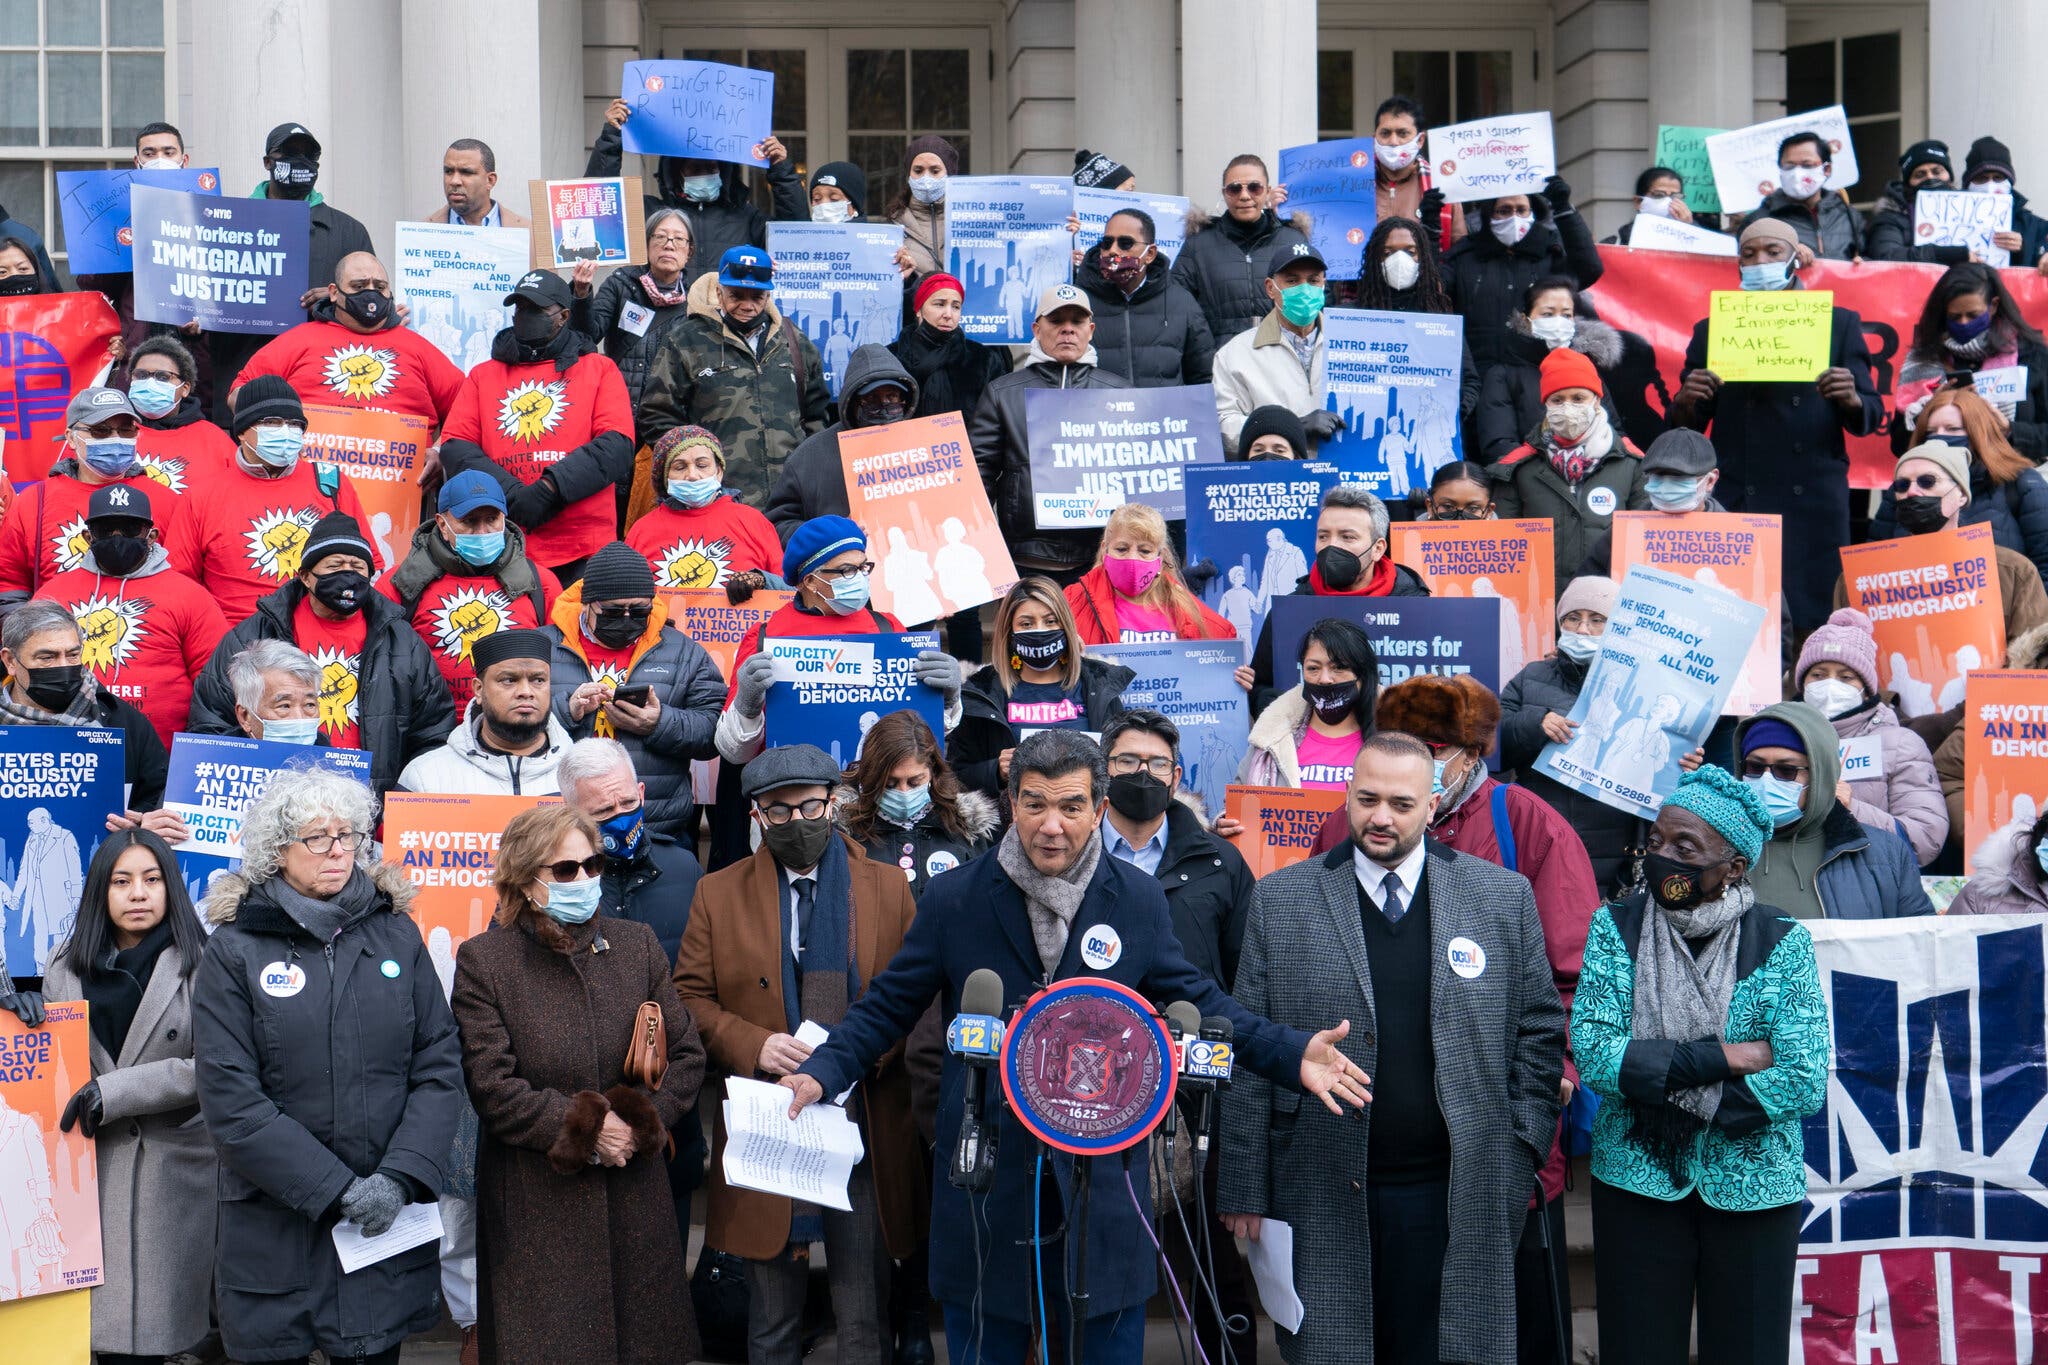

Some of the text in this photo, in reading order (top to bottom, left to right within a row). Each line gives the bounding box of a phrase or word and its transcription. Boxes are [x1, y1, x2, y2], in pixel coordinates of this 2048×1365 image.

[672, 98, 745, 126] HUMAN
[687, 127, 750, 153] RIGHT
[213, 208, 232, 220] NYIC
[951, 202, 1024, 211] INTRO #1867
[1006, 213, 1025, 221] OUR
[160, 220, 280, 246] New Yorkers for
[951, 221, 1006, 231] IMMIGRANT
[951, 230, 1050, 240] THROUGH MUNICIPAL
[950, 240, 1006, 249] ELECTIONS.
[152, 240, 286, 276] IMMIGRANT
[404, 248, 451, 259] WE NEED
[774, 251, 851, 261] INTRO #1867
[433, 260, 496, 272] DEMOCRACY
[774, 262, 852, 271] EMPOWERS OUR
[404, 268, 511, 282] THAT AND
[774, 272, 894, 281] IMMIGRANT COMMUNITY
[170, 273, 267, 304] JUSTICE
[404, 288, 455, 299] YORKERS.
[473, 283, 491, 291] ALL
[774, 281, 879, 291] THROUGH MUNICIPAL
[965, 324, 998, 333] 52886
[1328, 339, 1409, 353] INTRO #1867
[1721, 336, 1791, 350] MAKE
[1328, 351, 1410, 364] EMPOWERS OUR
[1327, 361, 1453, 377] IMMIGRANT COMMUNITY
[1327, 372, 1437, 388] THROUGH MUNICIPAL
[1326, 383, 1387, 395] ELECTIONS.
[1116, 401, 1135, 412] NYIC
[1060, 416, 1188, 438] New Yorkers for
[304, 432, 417, 456] #VOTEYES FOR
[305, 446, 414, 469] AN INCLUSIVE
[852, 441, 962, 474] #VOTEYES FOR
[1051, 437, 1198, 468] IMMIGRANT
[857, 455, 963, 488] AN INCLUSIVE
[863, 471, 961, 501] DEMOCRACY.
[1075, 466, 1183, 495] JUSTICE
[109, 487, 130, 506] NY
[1205, 481, 1321, 498] #VOTEYES FOR
[1043, 499, 1095, 509] OUR CITY
[1208, 494, 1318, 510] AN INCLUSIVE
[1062, 509, 1086, 519] OUR
[1214, 507, 1313, 522] DEMOCRACY.
[1643, 529, 1755, 544] #VOTEYES FOR
[1420, 539, 1528, 553] #VOTEYES FOR
[1645, 541, 1752, 555] AN INCLUSIVE
[1423, 551, 1526, 564] AN INCLUSIVE
[1651, 552, 1746, 567] DEMOCRACY.
[1429, 563, 1521, 576] DEMOCRACY.
[1855, 556, 1987, 592] #VOTEYES FOR
[1861, 573, 1987, 607] AN INCLUSIVE
[1620, 597, 1666, 621] WE NEED A
[1867, 590, 1984, 622] DEMOCRACY.
[685, 607, 760, 621] #VOTEYES
[1376, 612, 1400, 626] NYIC
[686, 619, 707, 629] AN
[1635, 616, 1703, 649] DEMOCRACY
[773, 646, 837, 660] OUR CITY
[1016, 640, 1064, 659] MIXTECA
[1432, 635, 1462, 657] for
[1610, 623, 1715, 669] THAT AND
[1601, 647, 1637, 669] YORKERS.
[795, 660, 824, 672] OUR
[1659, 654, 1721, 686] ALL NEW
[1131, 677, 1180, 690] #1867
[799, 687, 912, 704] DEMOCRACY.
[1157, 691, 1183, 702] OUR
[1010, 698, 1076, 722] MIXTECA
[1161, 700, 1238, 714] COMMUNITY
[1983, 722, 2013, 738] AN
[175, 737, 259, 749] WWW.OURCITYOURVOTE.ORG
[325, 751, 340, 759] OUR
[60, 752, 99, 768] FOR
[195, 777, 224, 794] AN
[1558, 758, 1580, 773] TEXT
[1599, 777, 1613, 790] TO
[1615, 783, 1652, 805] 52886
[1262, 821, 1285, 833] AN
[194, 828, 228, 844] OUR
[402, 850, 433, 868] AN
[50, 1008, 70, 1016] CITY
[961, 1018, 986, 1028] news
[13, 1032, 52, 1050] FOR
[959, 1027, 985, 1048] 12
[1210, 1043, 1230, 1067] 2
[1188, 1063, 1229, 1077] NEWS
[62, 1270, 78, 1279] TEXT
[76, 1275, 98, 1284] 52886
